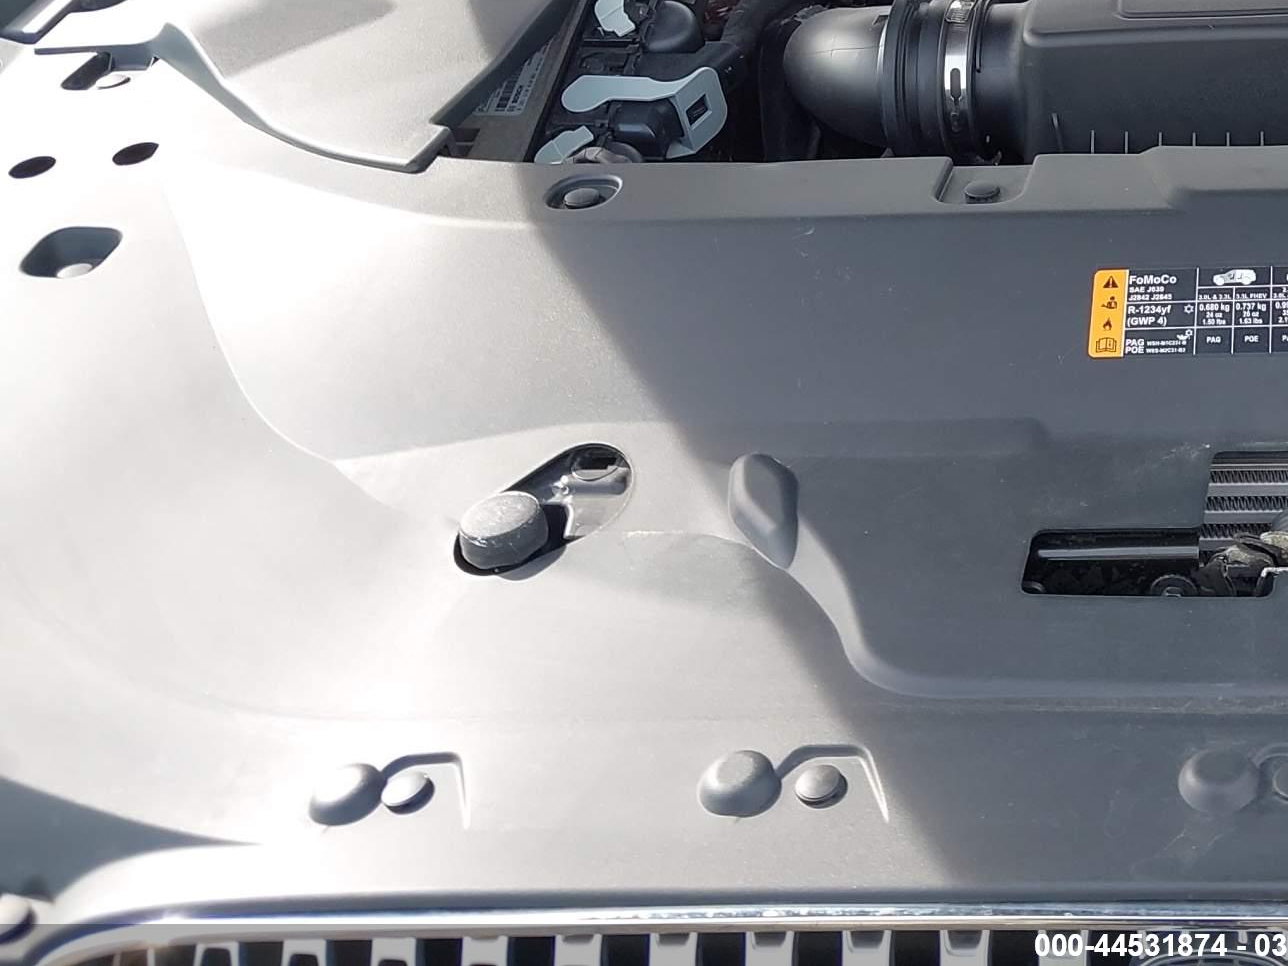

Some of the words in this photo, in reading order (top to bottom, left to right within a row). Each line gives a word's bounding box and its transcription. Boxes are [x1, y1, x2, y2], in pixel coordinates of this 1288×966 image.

[1129, 274, 1177, 285] FoMoCo
[1128, 305, 1171, 315] R-1234yf
[1221, 303, 1230, 312] kg
[1236, 302, 1255, 310] 0.737
[1257, 302, 1266, 311] kg
[1127, 316, 1155, 327] (GWP
[1157, 316, 1167, 326] 4)
